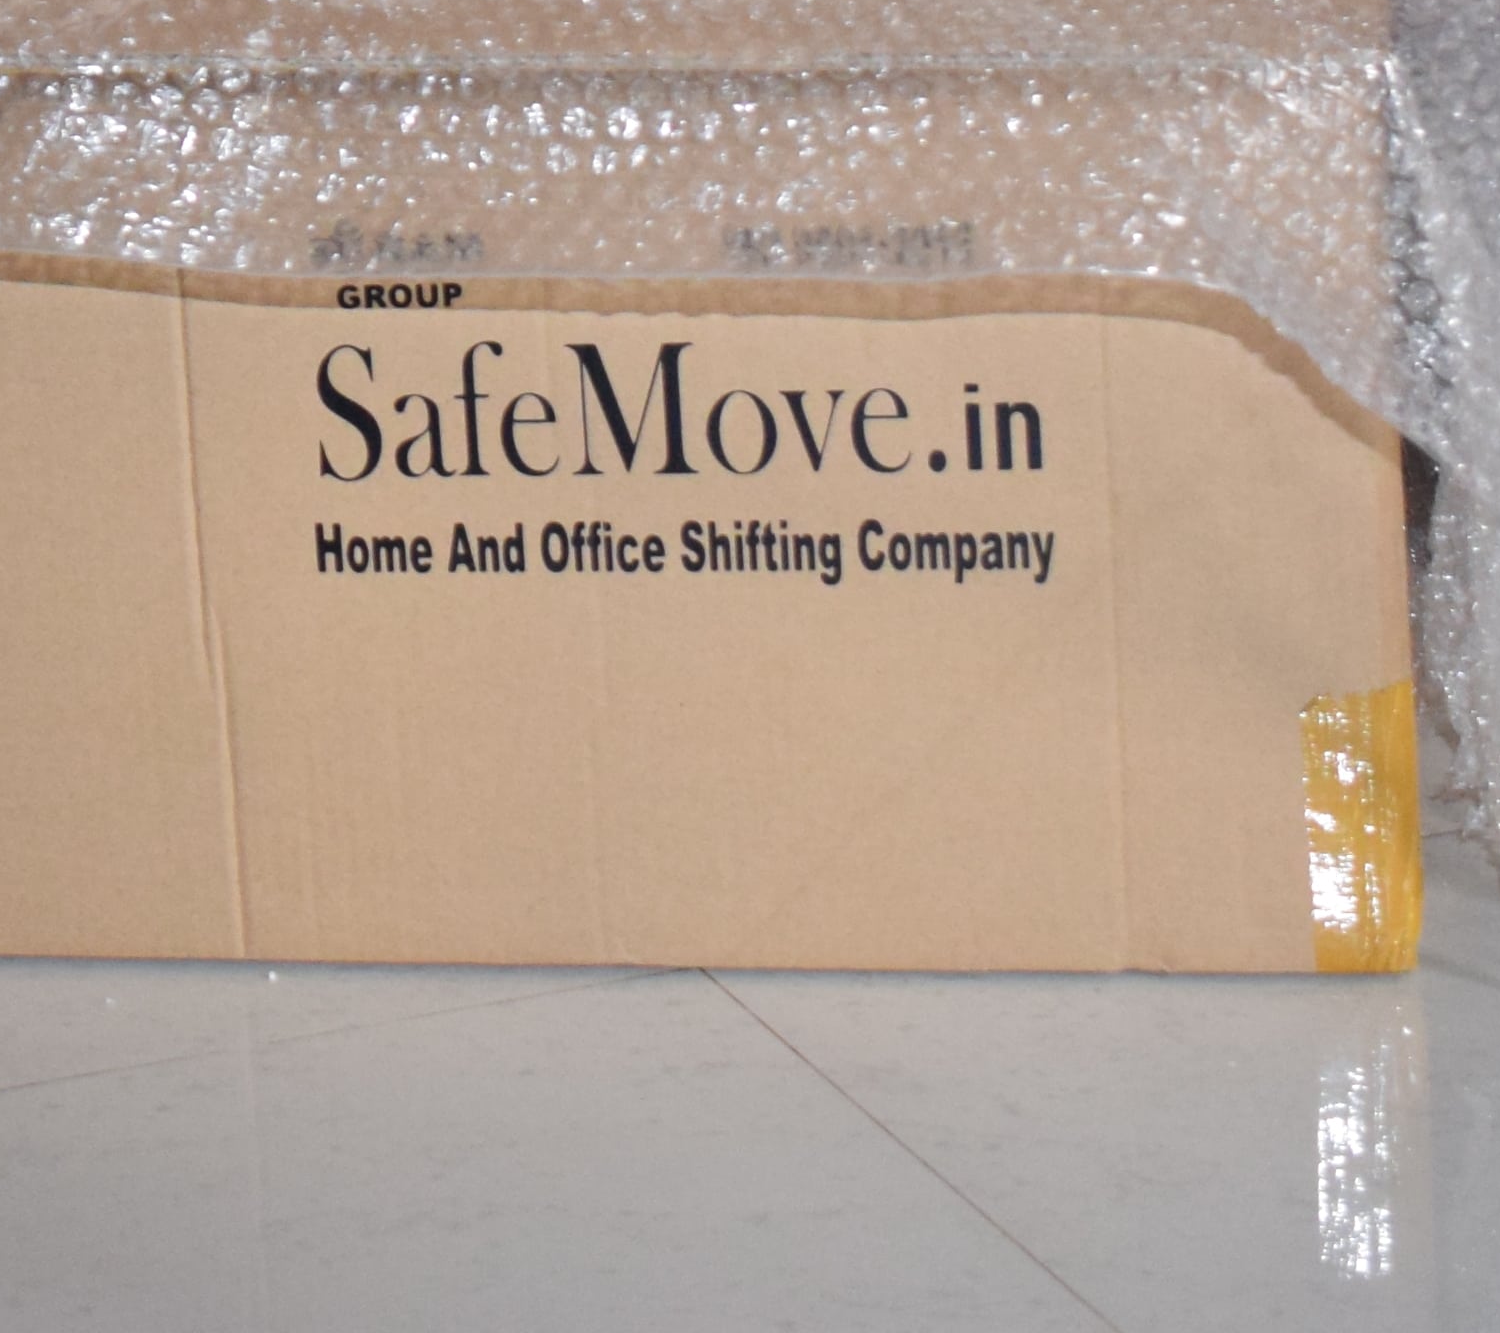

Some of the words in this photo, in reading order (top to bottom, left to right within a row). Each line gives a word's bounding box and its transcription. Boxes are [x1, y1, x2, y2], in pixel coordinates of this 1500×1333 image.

[337, 283, 462, 309] GROUP
[316, 340, 1044, 483] SafeMove.in
[314, 523, 434, 574] Home
[448, 523, 527, 574] And
[541, 521, 667, 574] Office
[681, 519, 843, 587] Shifting
[858, 518, 1056, 585] Company
